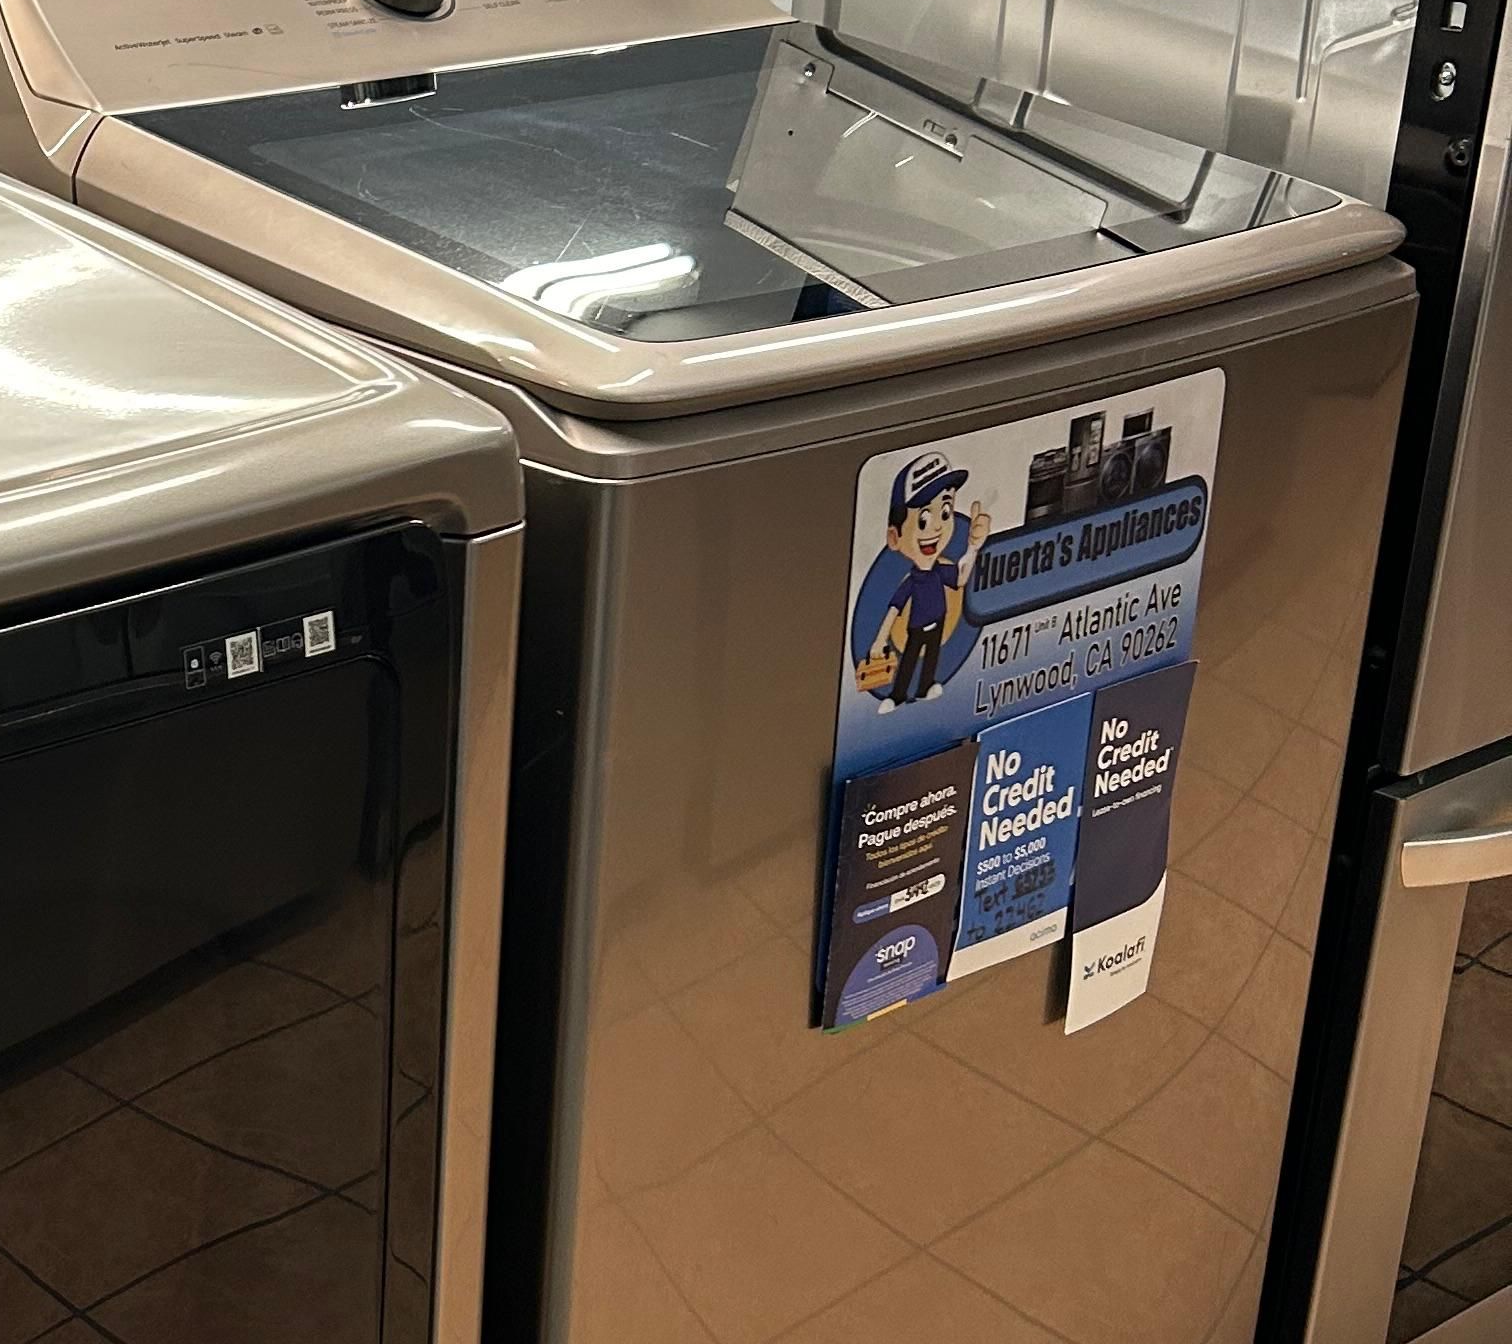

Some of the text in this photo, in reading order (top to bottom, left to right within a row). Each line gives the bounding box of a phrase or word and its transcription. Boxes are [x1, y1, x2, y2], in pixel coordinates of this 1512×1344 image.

[973, 494, 1202, 592] Huerta's Appliances
[980, 624, 1033, 669] 11671
[1058, 599, 1138, 646] Atlantic
[1143, 582, 1182, 614] Ave
[974, 617, 1178, 715] Lynwood, CA 90262
[1098, 729, 1159, 770] Credit
[1100, 717, 1128, 744] No
[985, 749, 1021, 784] No
[1094, 748, 1170, 798] Needed
[864, 786, 957, 826] Compre ahora.
[983, 765, 1055, 816] Credit
[858, 804, 957, 848] Pague después.
[979, 786, 1075, 851] Needed
[976, 869, 1006, 892] Instant
[1008, 852, 1050, 877] Decisions
[977, 837, 1046, 875] $500 to $5,000
[975, 880, 1008, 914] Text
[876, 935, 916, 963] snap
[1097, 935, 1145, 975] Koalafi
